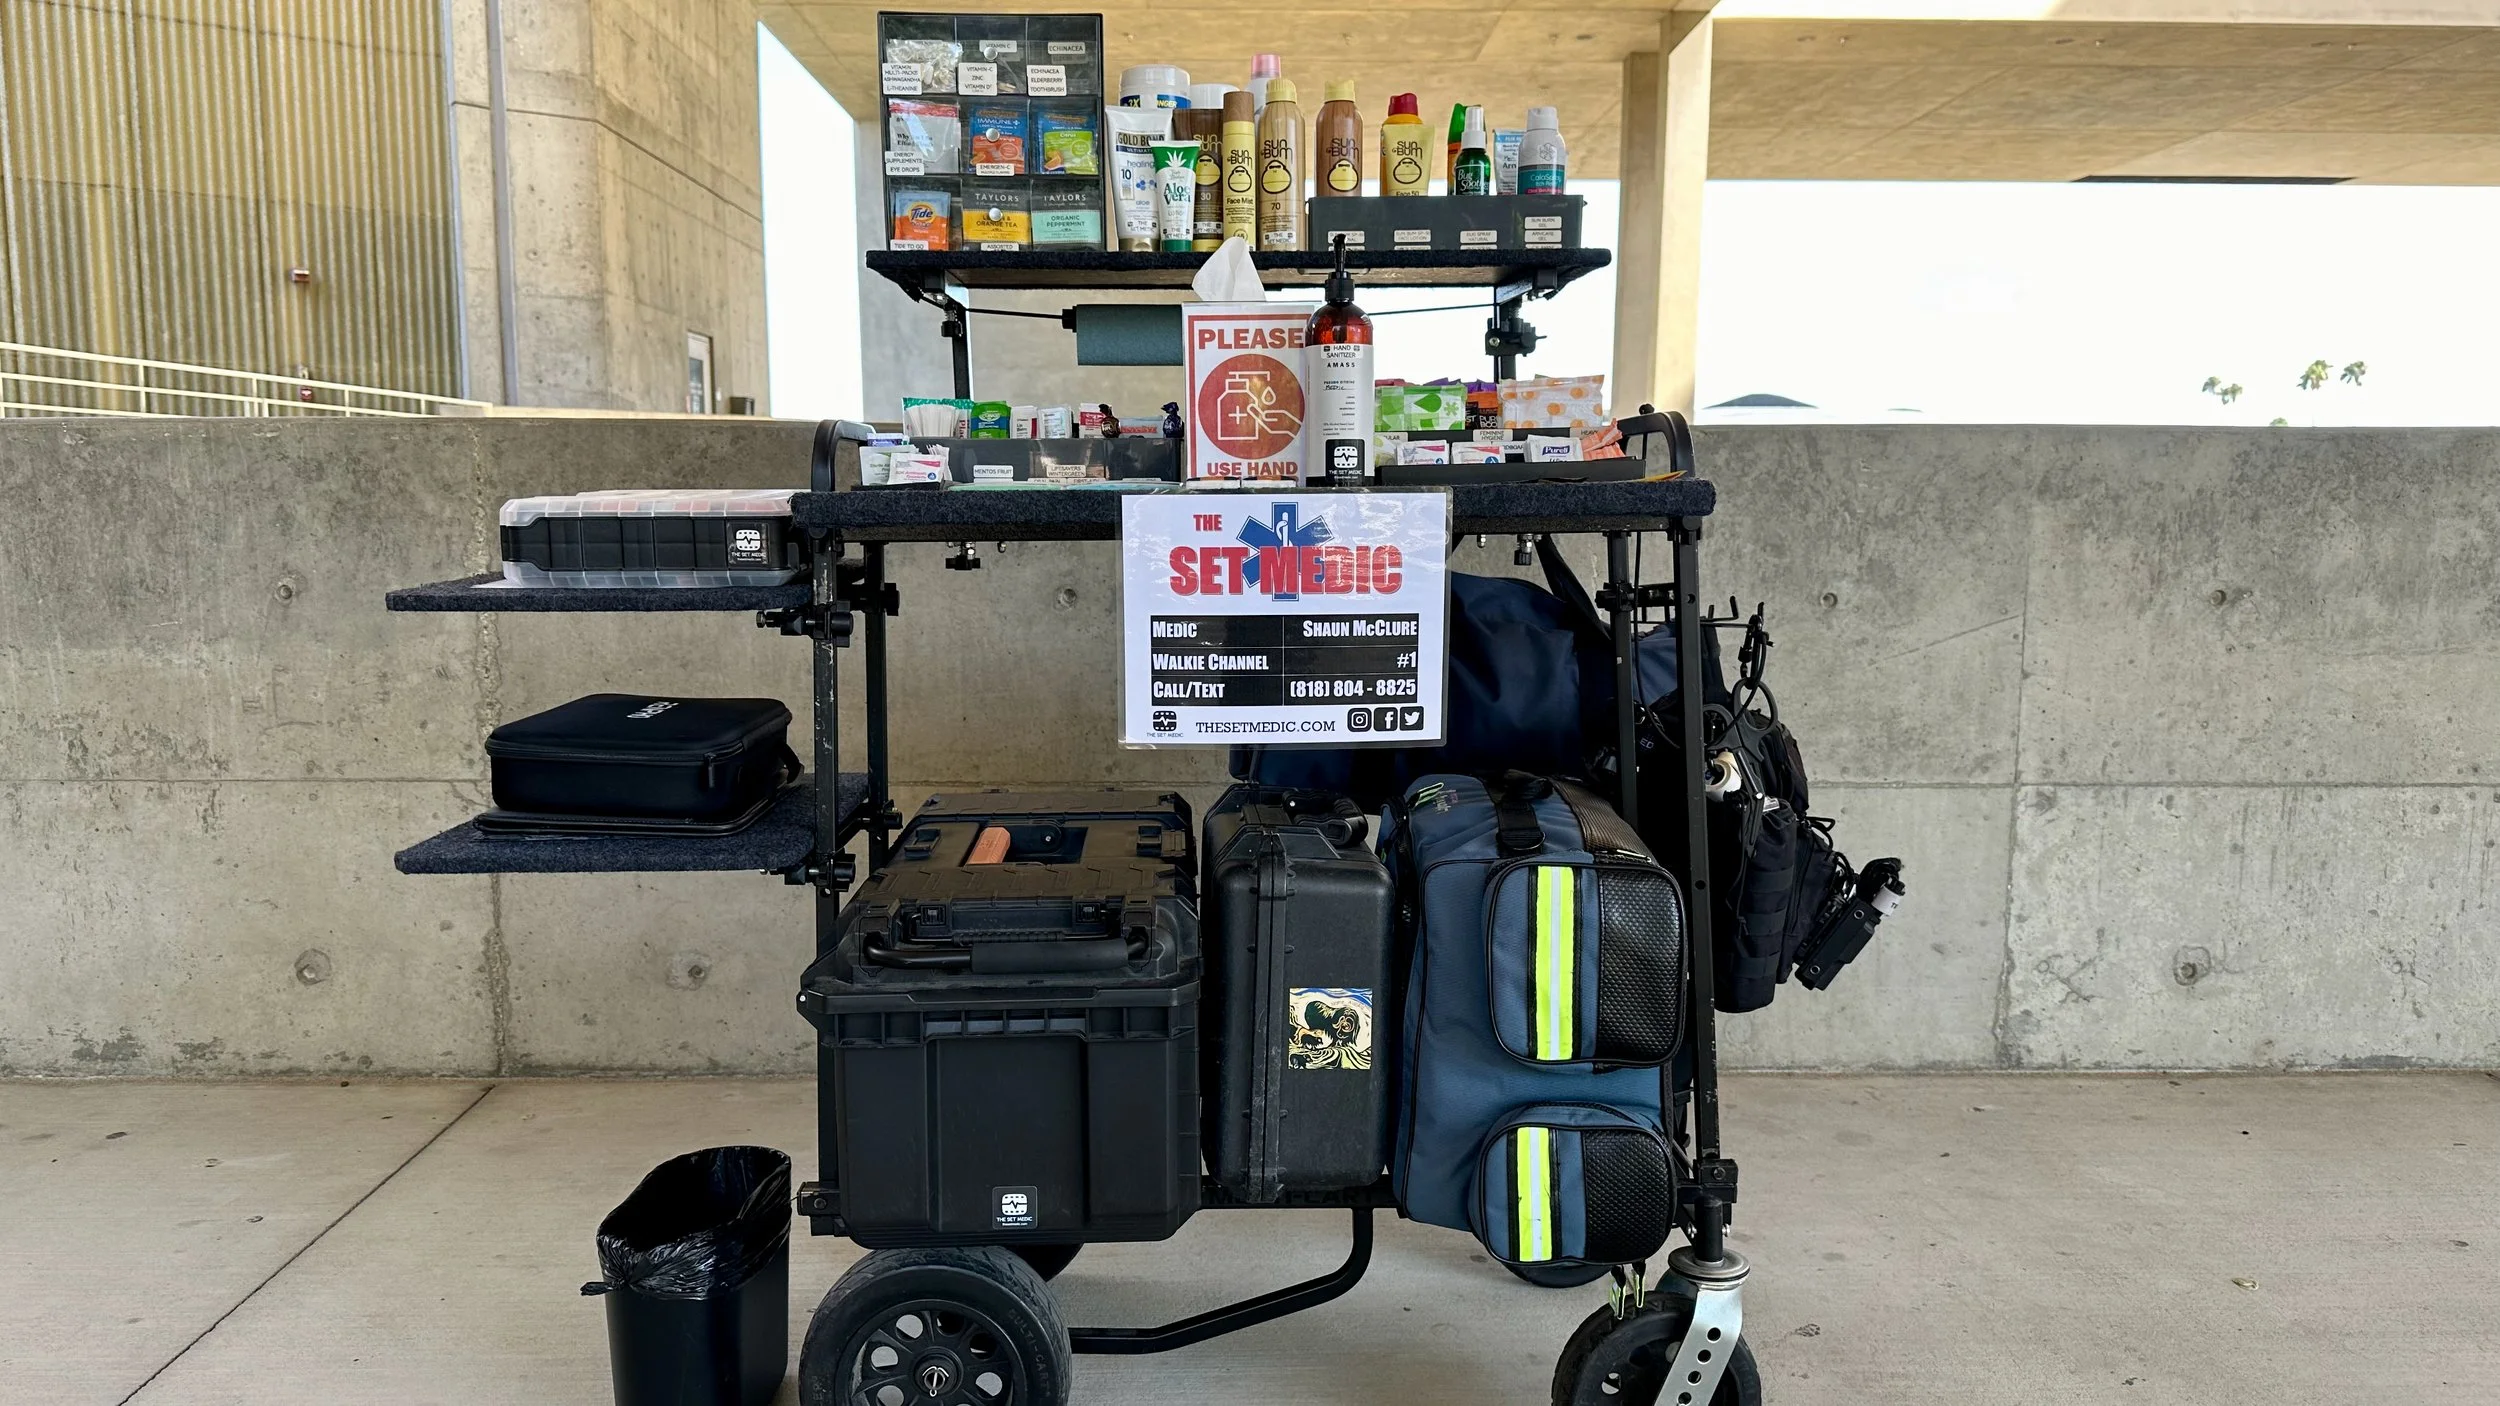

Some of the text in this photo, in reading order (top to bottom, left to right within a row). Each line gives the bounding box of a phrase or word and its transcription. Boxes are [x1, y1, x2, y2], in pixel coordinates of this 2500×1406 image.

[1118, 133, 1139, 146] GOLD
[1121, 169, 1132, 180] 10
[1164, 183, 1191, 195] Aloe
[975, 194, 1019, 202] TAYLORS
[1200, 193, 1212, 201] 30
[1271, 203, 1281, 211] 70
[911, 208, 933, 220] Tide
[1198, 328, 1304, 350] PLEASE
[1207, 462, 1298, 477] USE HAND
[1193, 514, 1222, 531] THE
[1169, 545, 1403, 595] SET MEDIC
[1153, 621, 1197, 638] MEDIC
[1303, 621, 1349, 637] SHAUN
[1153, 652, 1417, 671] WALKIE CHANNEL #1
[1153, 682, 1225, 699] CALL/TEXT
[1290, 681, 1330, 698] (818)
[1333, 680, 1364, 697] 804
[1375, 679, 1416, 696] 8825
[1195, 721, 1336, 734] THESETMEDIC.COM
